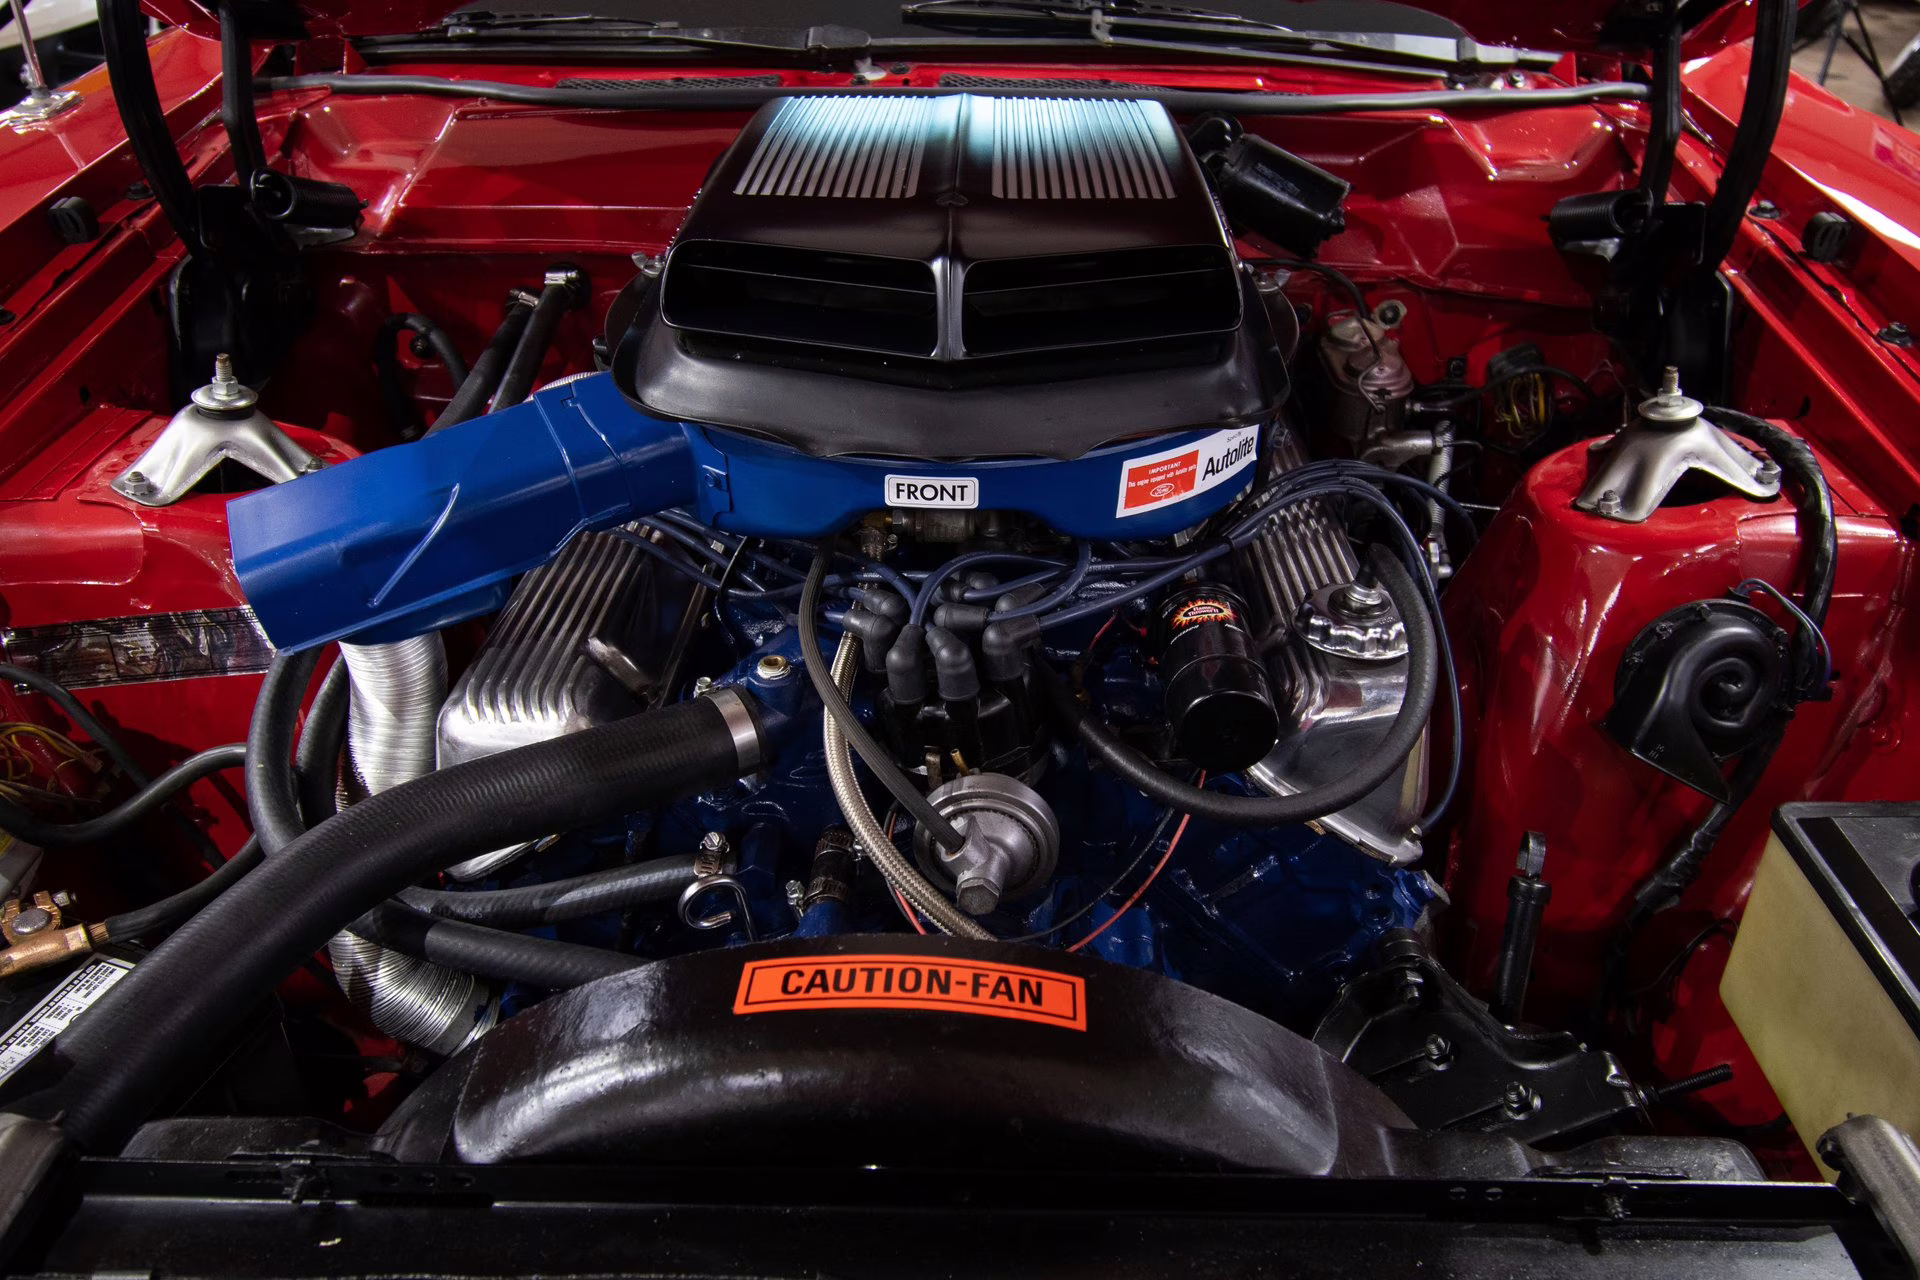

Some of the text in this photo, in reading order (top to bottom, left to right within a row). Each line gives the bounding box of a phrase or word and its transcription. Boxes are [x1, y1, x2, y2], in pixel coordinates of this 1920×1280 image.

[1148, 461, 1181, 475] IMPORTANT
[1202, 436, 1254, 481] Autolite
[896, 482, 968, 502] FRONT
[780, 967, 1043, 1008] CAUTION-FAN
